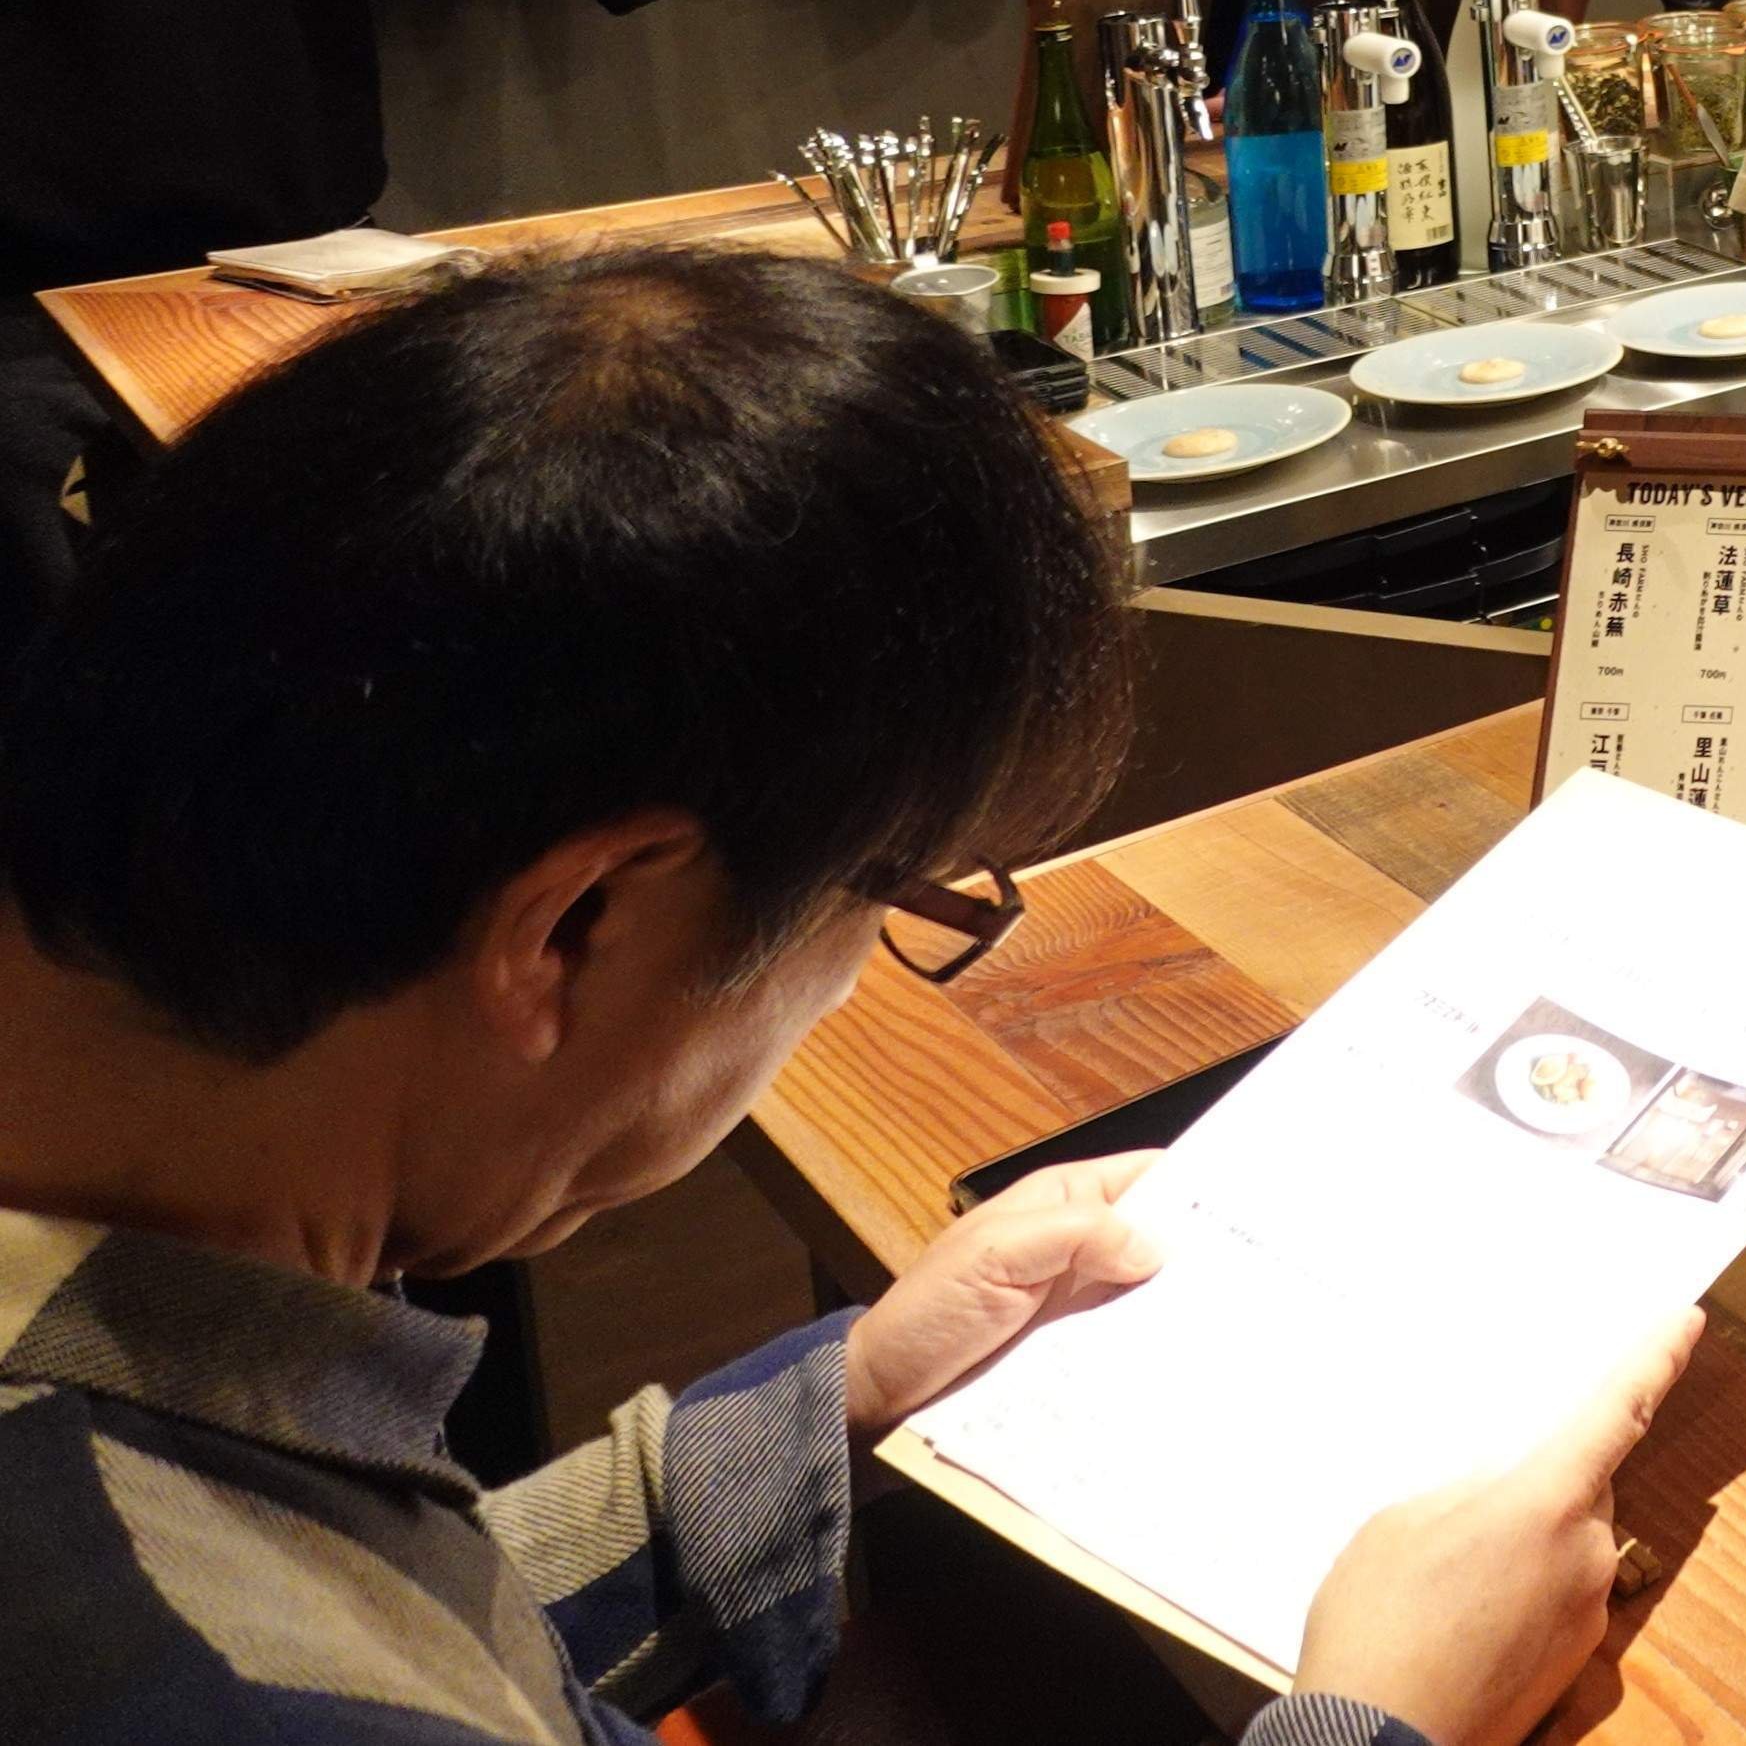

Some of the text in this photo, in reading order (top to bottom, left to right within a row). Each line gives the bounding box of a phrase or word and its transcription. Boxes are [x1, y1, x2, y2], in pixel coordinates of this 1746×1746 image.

[1627, 482, 1713, 506] TODAY'S
[1605, 542, 1635, 637] 長崎赤蕪
[1711, 545, 1738, 615] 法蓮草
